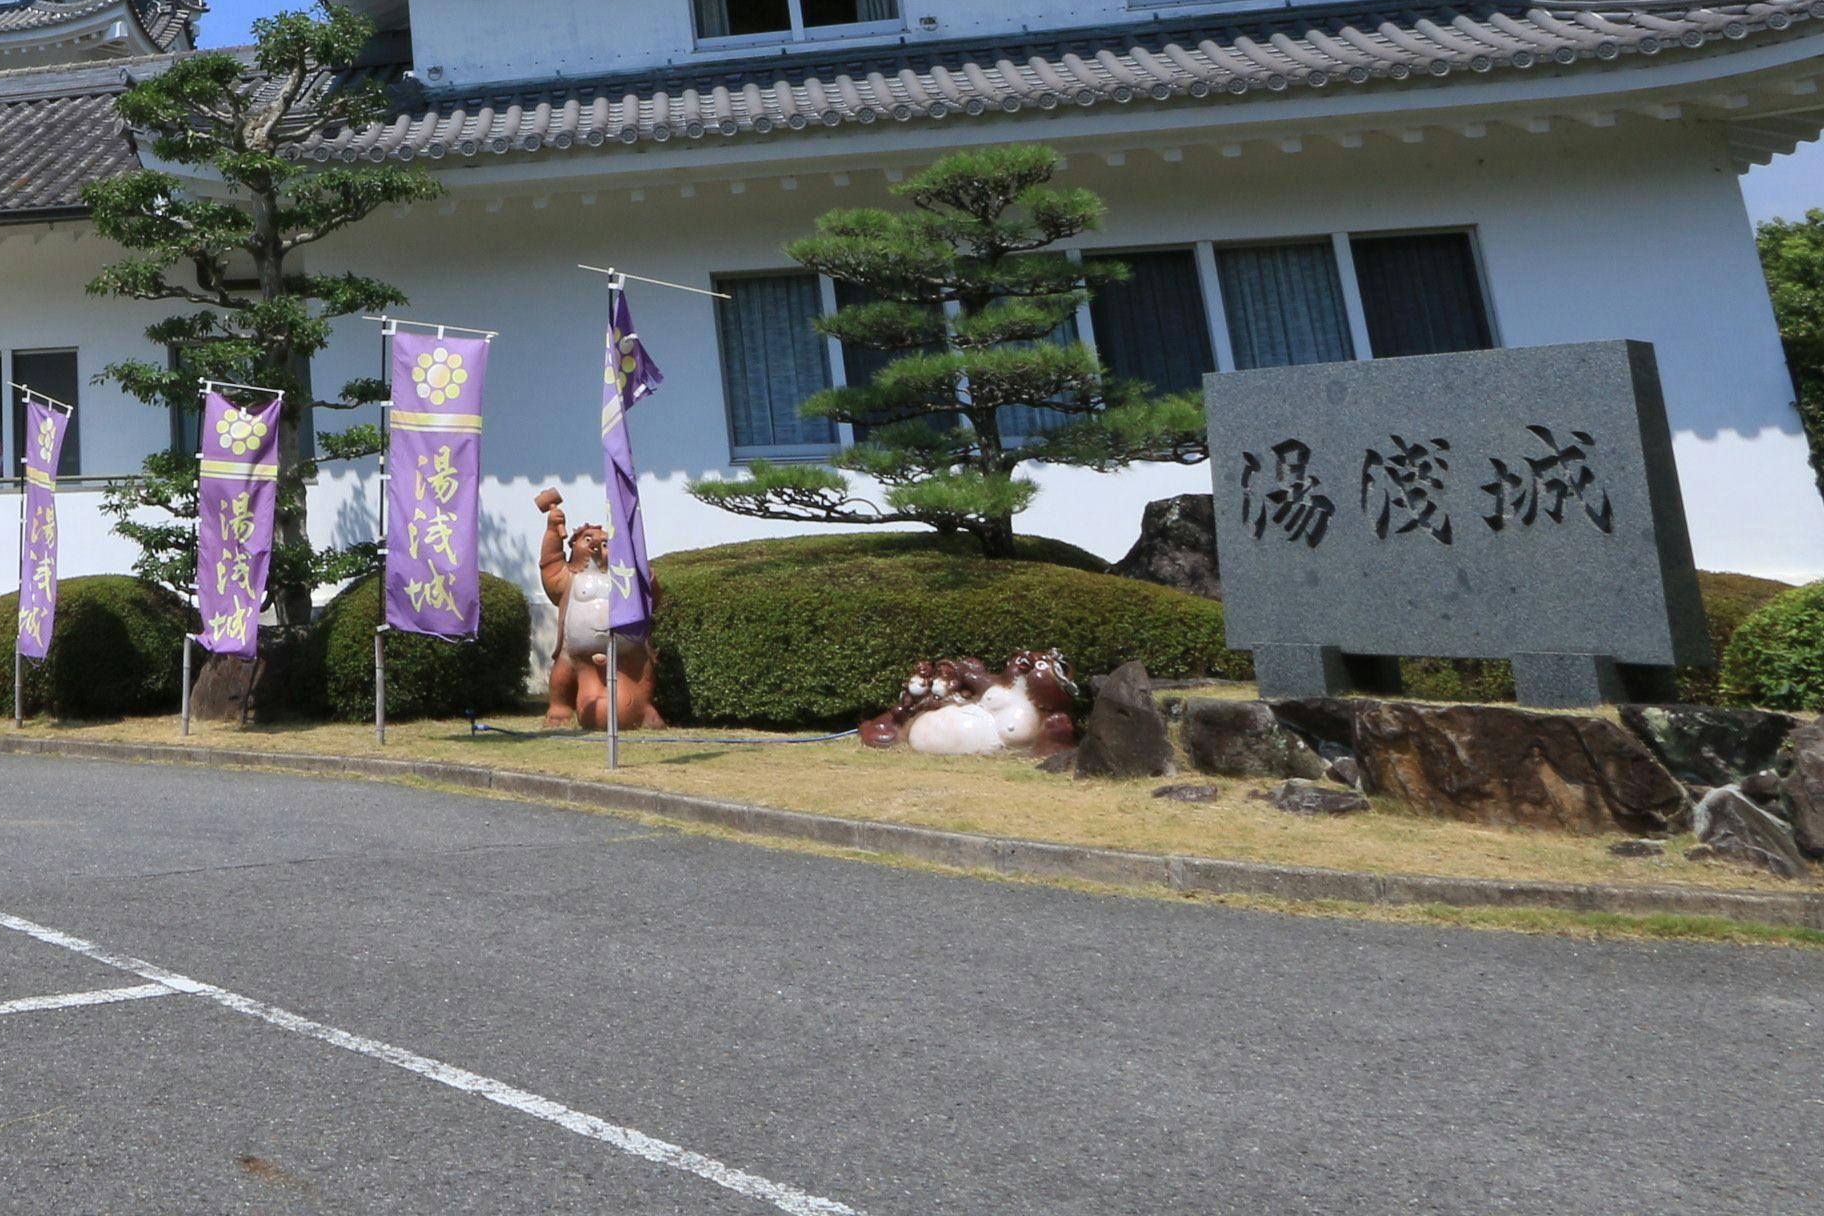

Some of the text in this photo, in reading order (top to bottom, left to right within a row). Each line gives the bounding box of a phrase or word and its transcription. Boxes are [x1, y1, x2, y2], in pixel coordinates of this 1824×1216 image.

[208, 491, 256, 646] 湯浅城
[404, 444, 464, 621] 湯浅城
